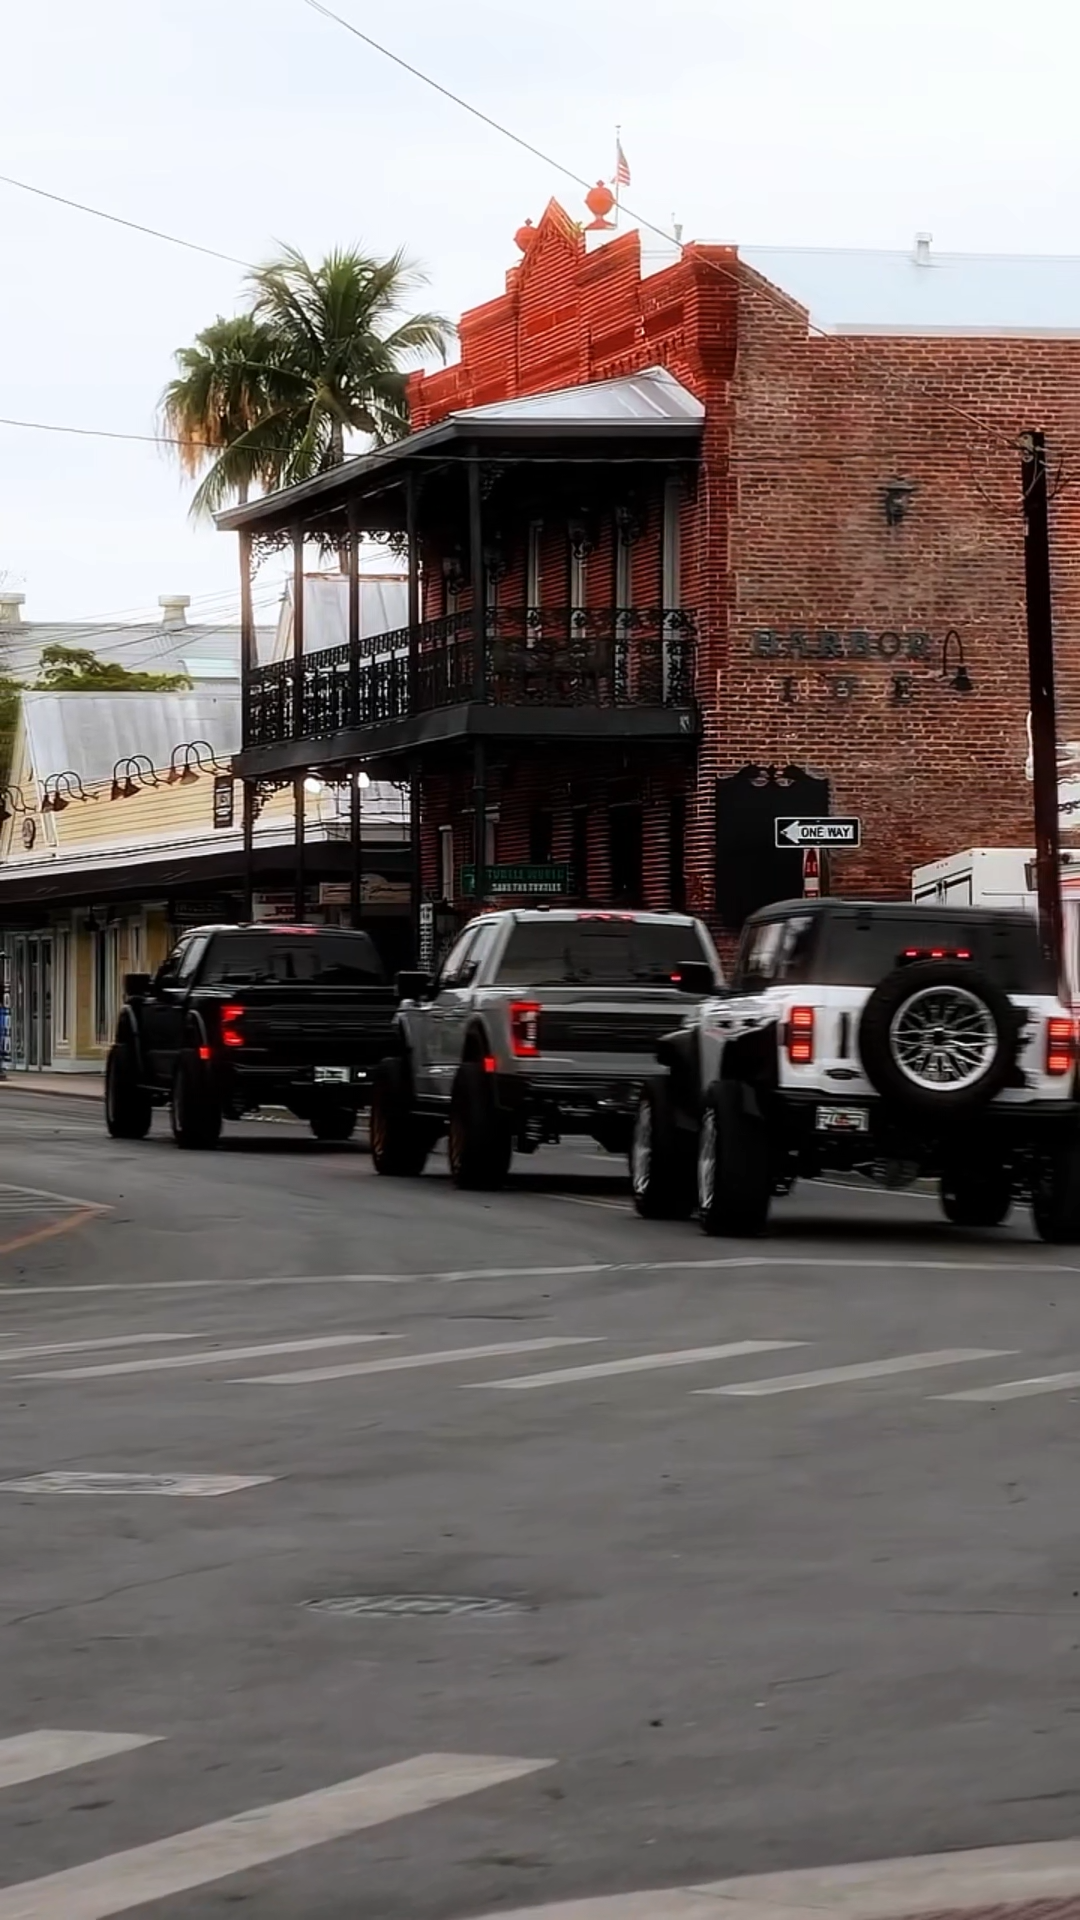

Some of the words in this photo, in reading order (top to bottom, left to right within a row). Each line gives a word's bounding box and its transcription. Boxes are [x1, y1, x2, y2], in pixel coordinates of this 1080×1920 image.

[752, 630, 930, 659] HARBOR
[801, 827, 824, 838] ONE
[827, 827, 850, 838] WAY
